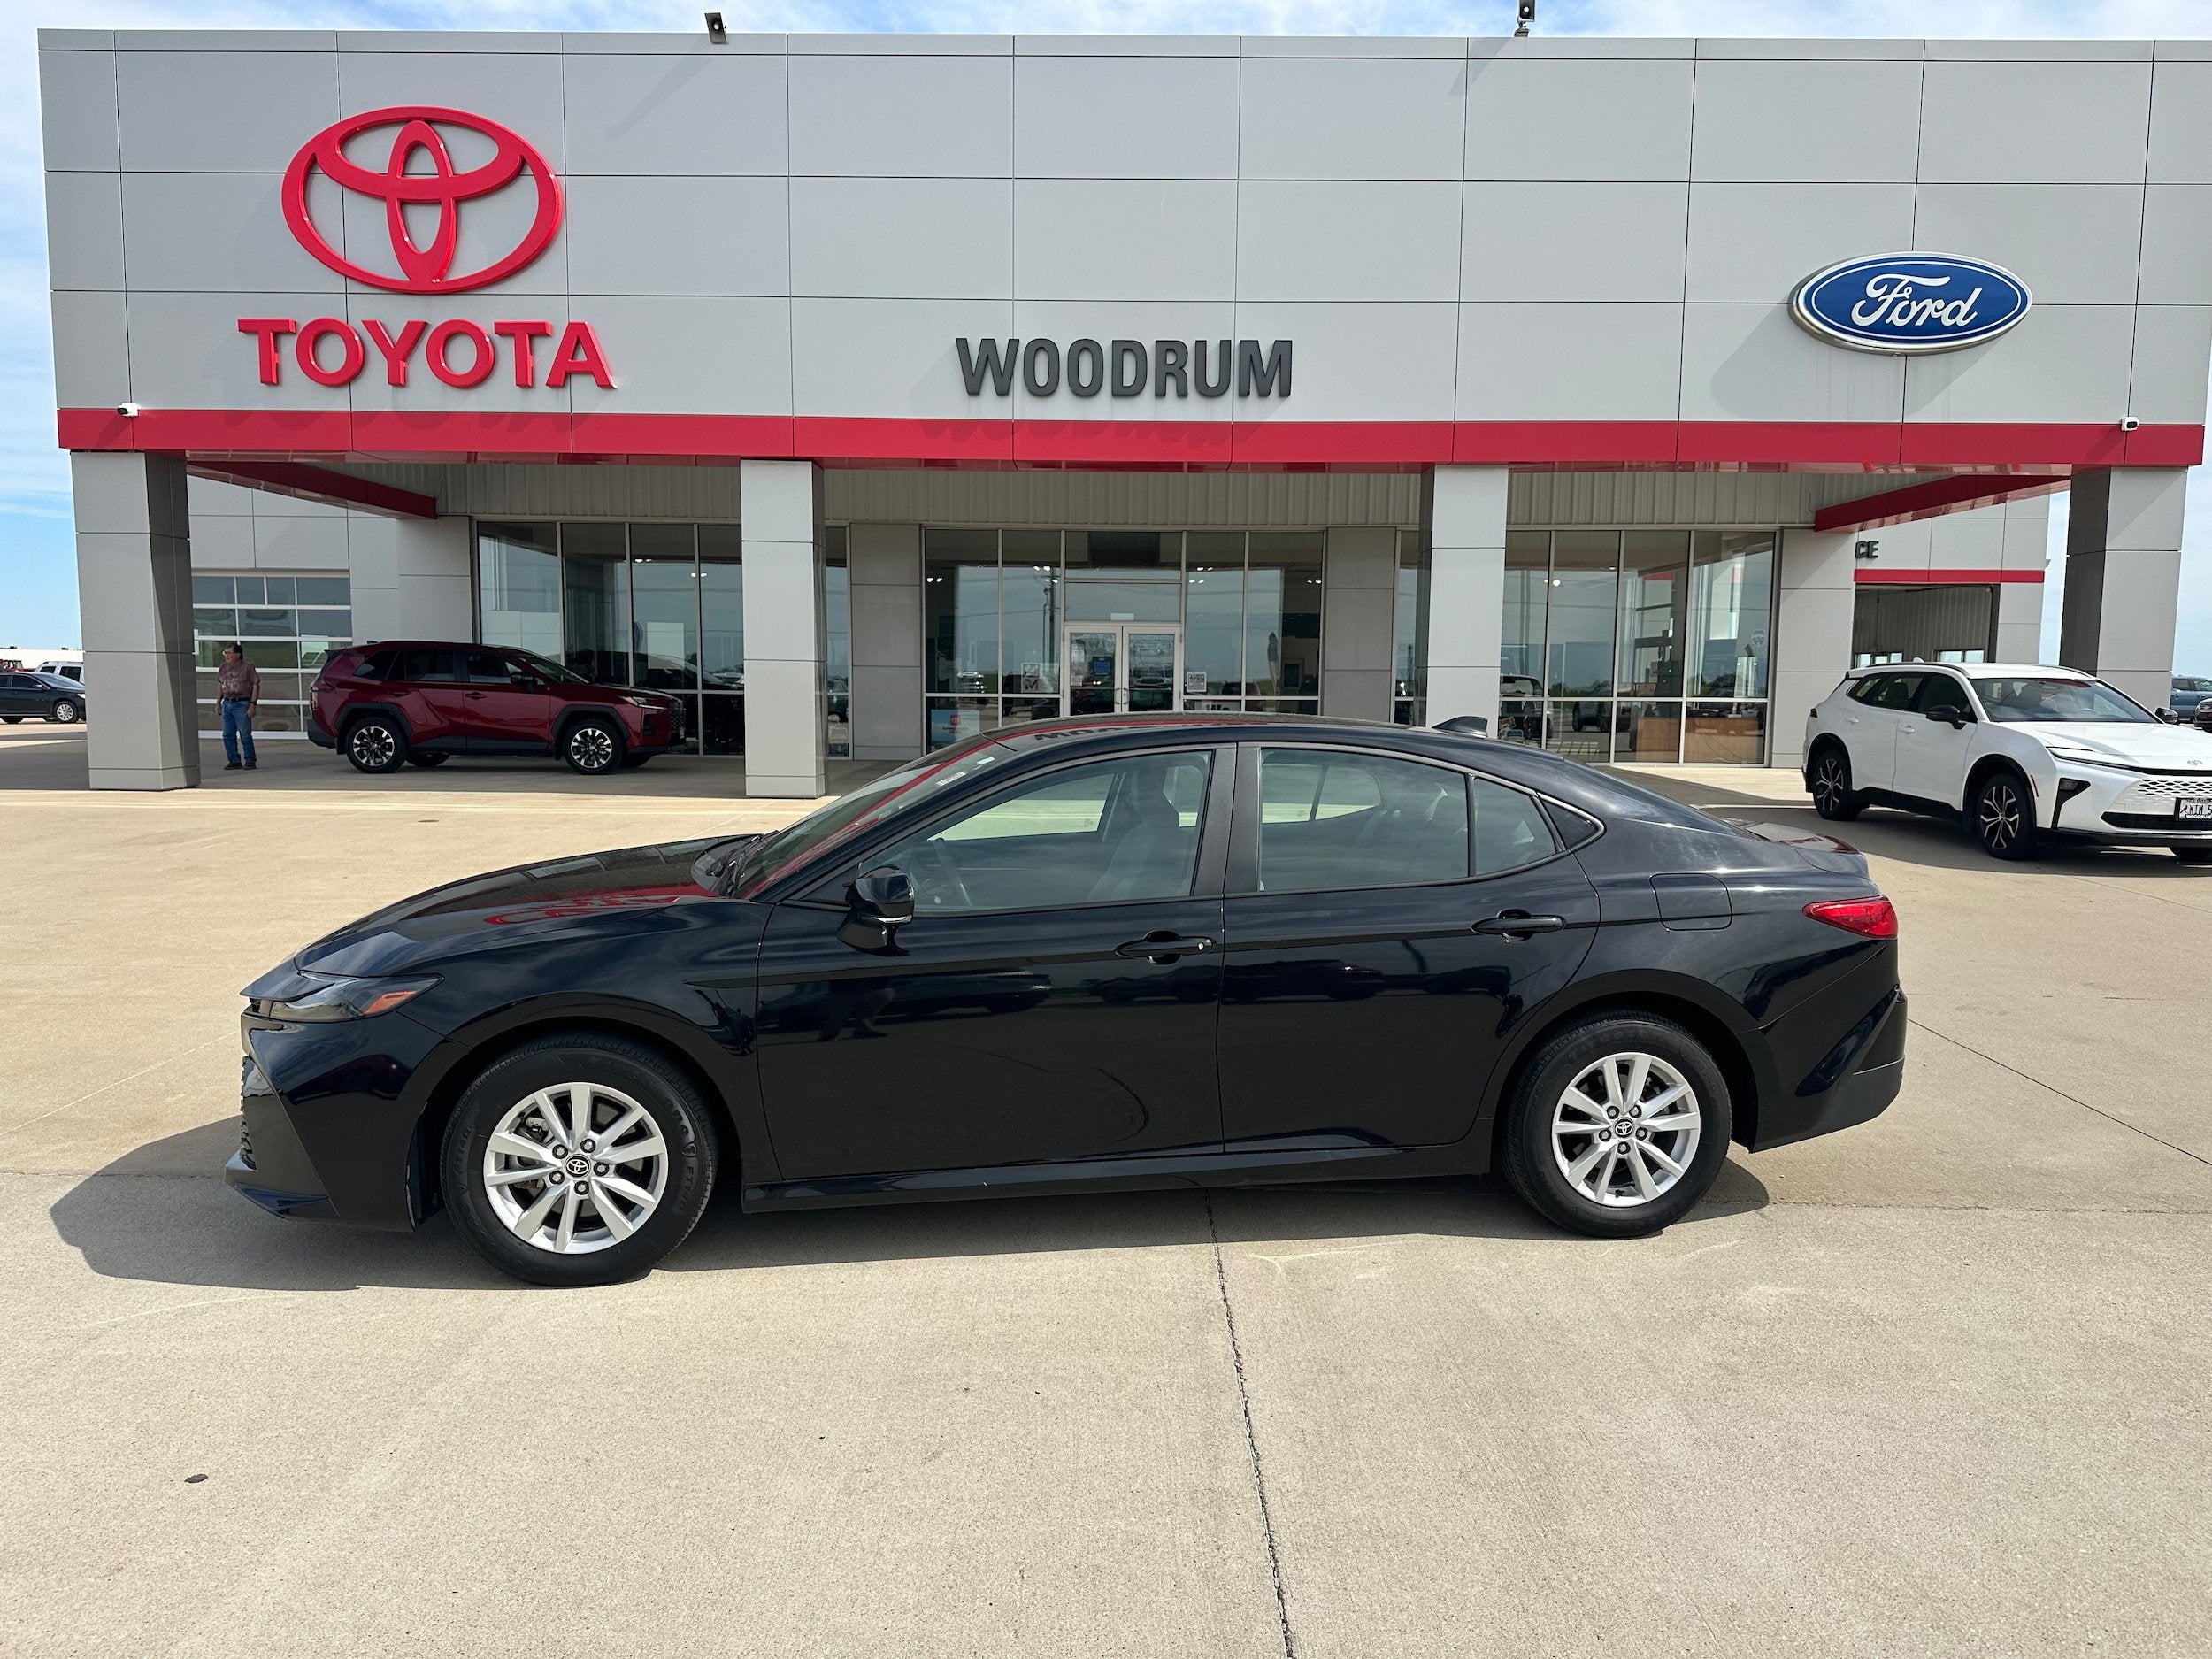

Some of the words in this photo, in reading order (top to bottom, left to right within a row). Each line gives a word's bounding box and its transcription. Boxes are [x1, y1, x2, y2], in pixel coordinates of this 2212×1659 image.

[1851, 273, 1983, 326] Ford
[237, 318, 618, 389] TOYOTA
[956, 337, 1293, 397] WOODRUM
